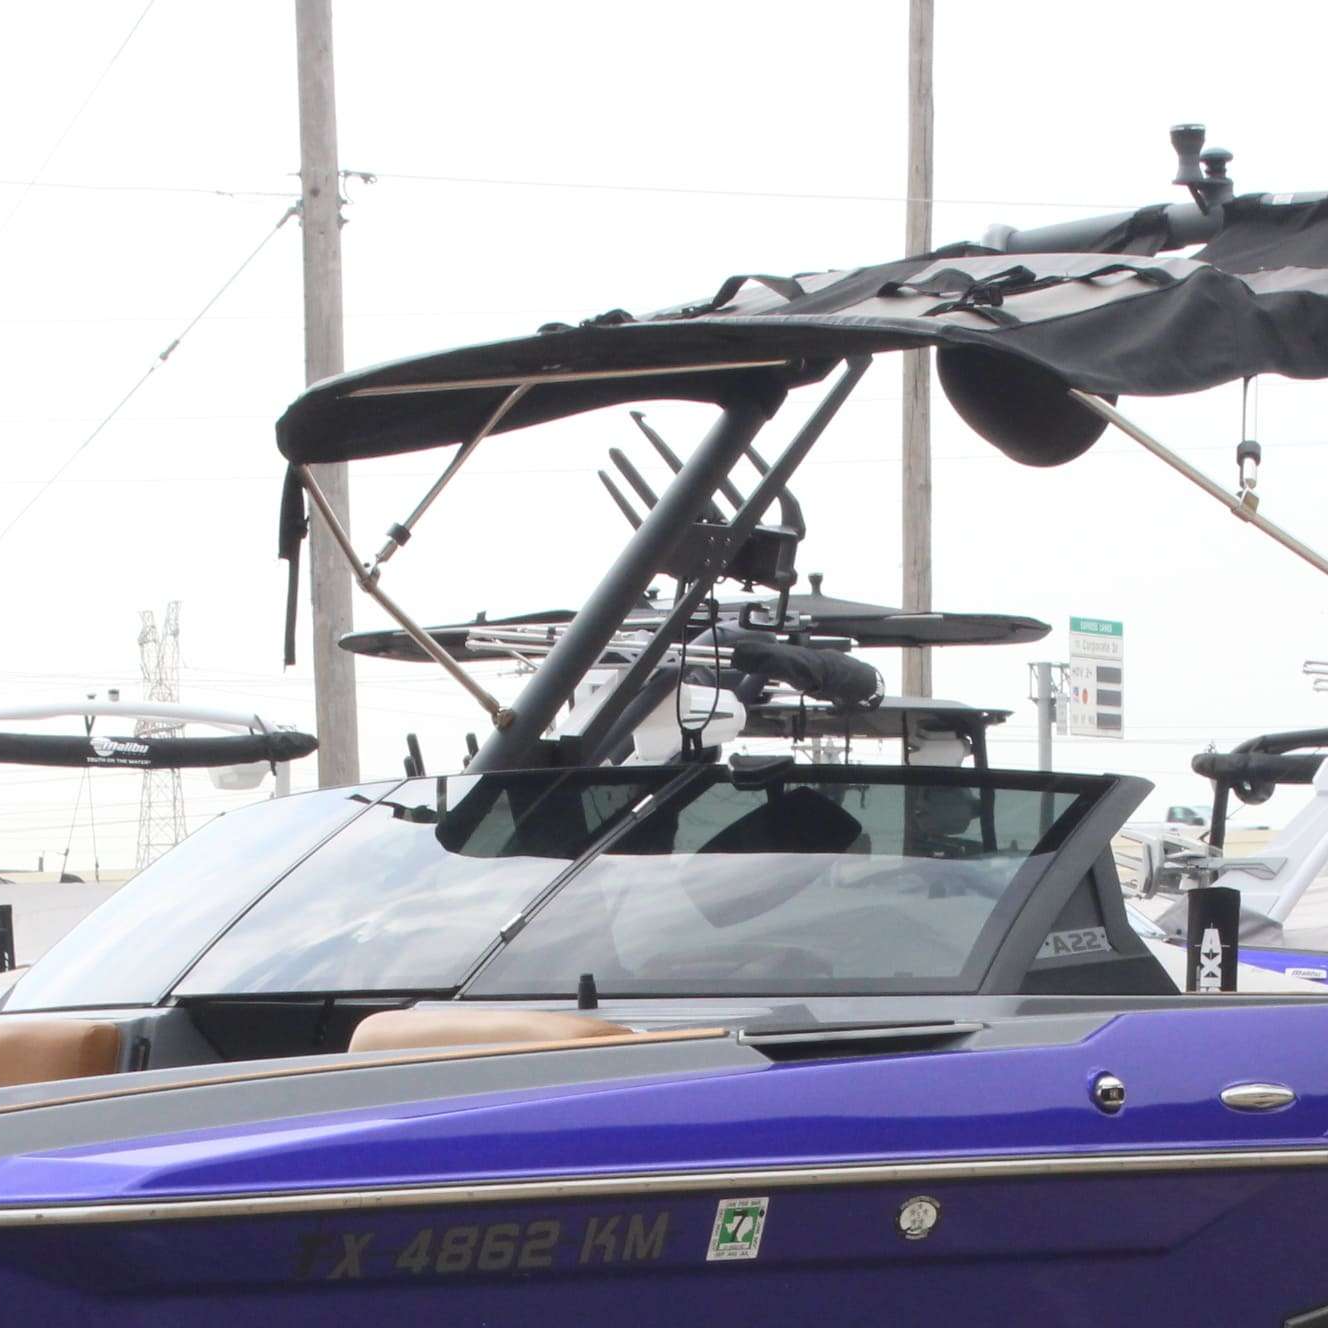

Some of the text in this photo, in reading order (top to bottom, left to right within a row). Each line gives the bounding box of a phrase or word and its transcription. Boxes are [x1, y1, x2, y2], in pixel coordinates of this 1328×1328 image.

[1052, 931, 1102, 954] A22
[395, 1220, 561, 1274] 4862
[579, 1211, 671, 1265] KM
